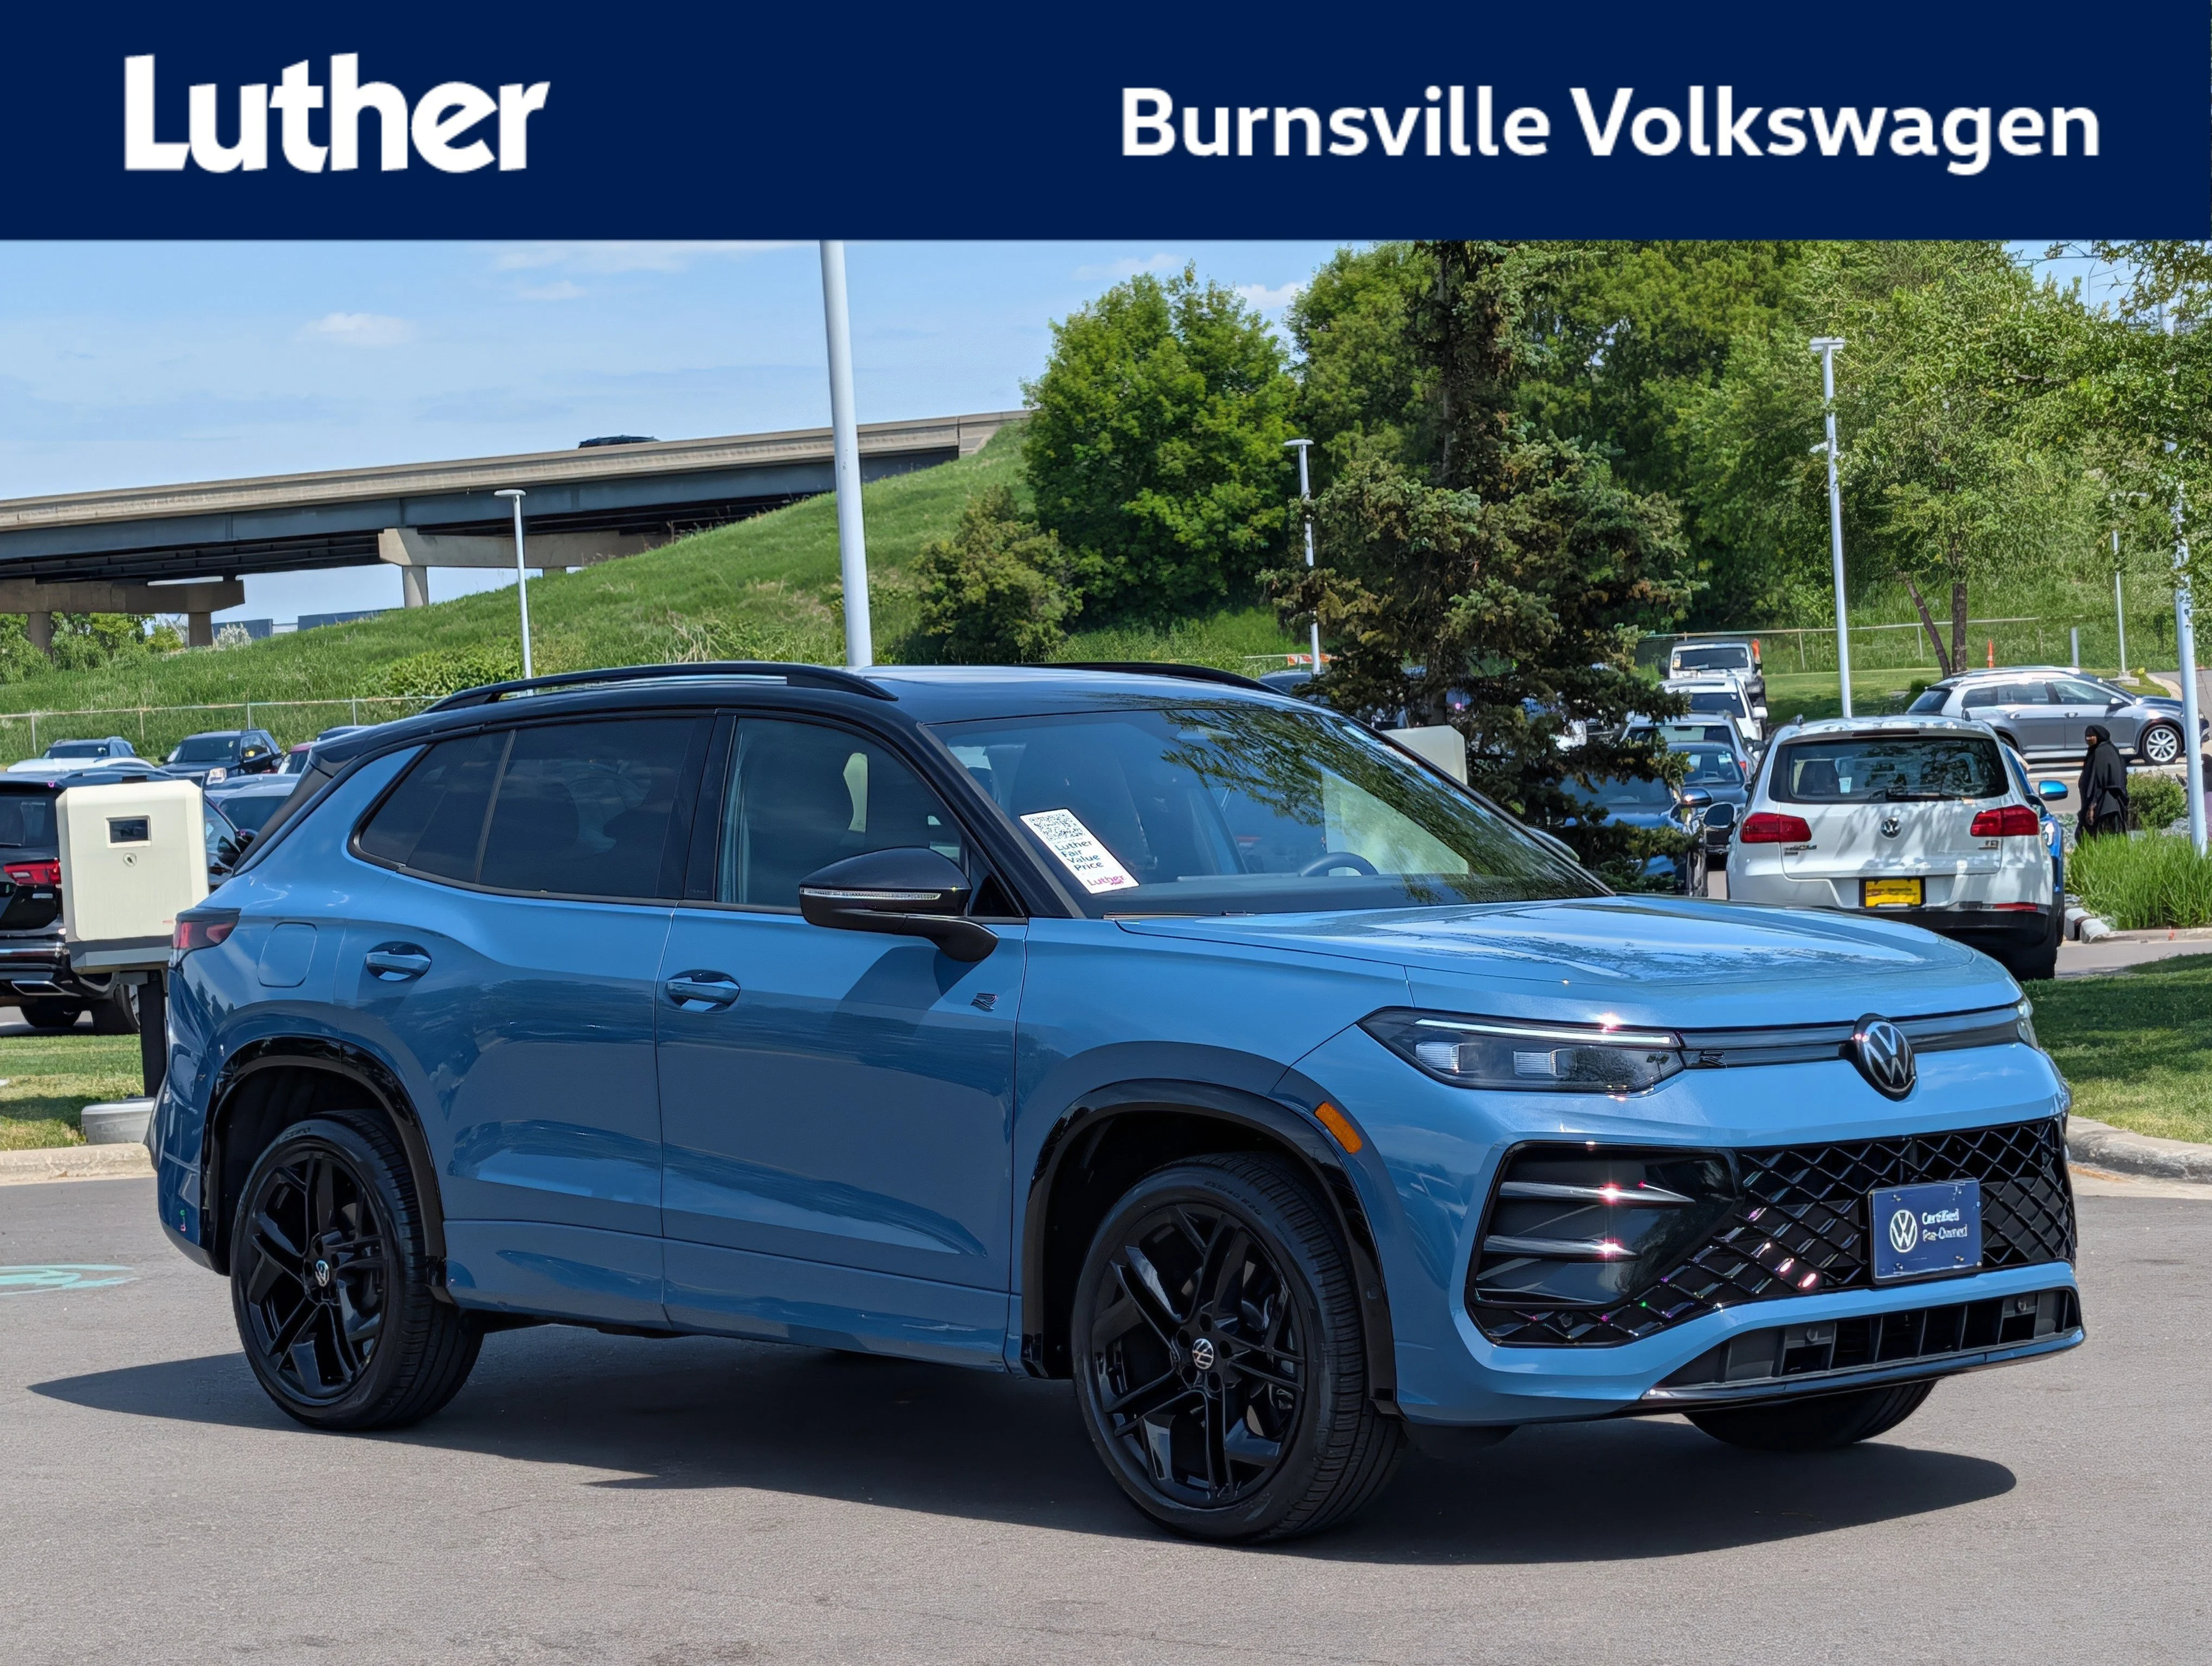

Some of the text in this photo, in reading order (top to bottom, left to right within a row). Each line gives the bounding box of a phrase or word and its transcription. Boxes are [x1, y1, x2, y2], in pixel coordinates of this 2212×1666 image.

[1054, 841, 1092, 851] Luther
[1061, 849, 1083, 858] Fair
[1066, 855, 1101, 864] Value
[1073, 862, 1104, 872] Price
[1086, 875, 1124, 886] Luther
